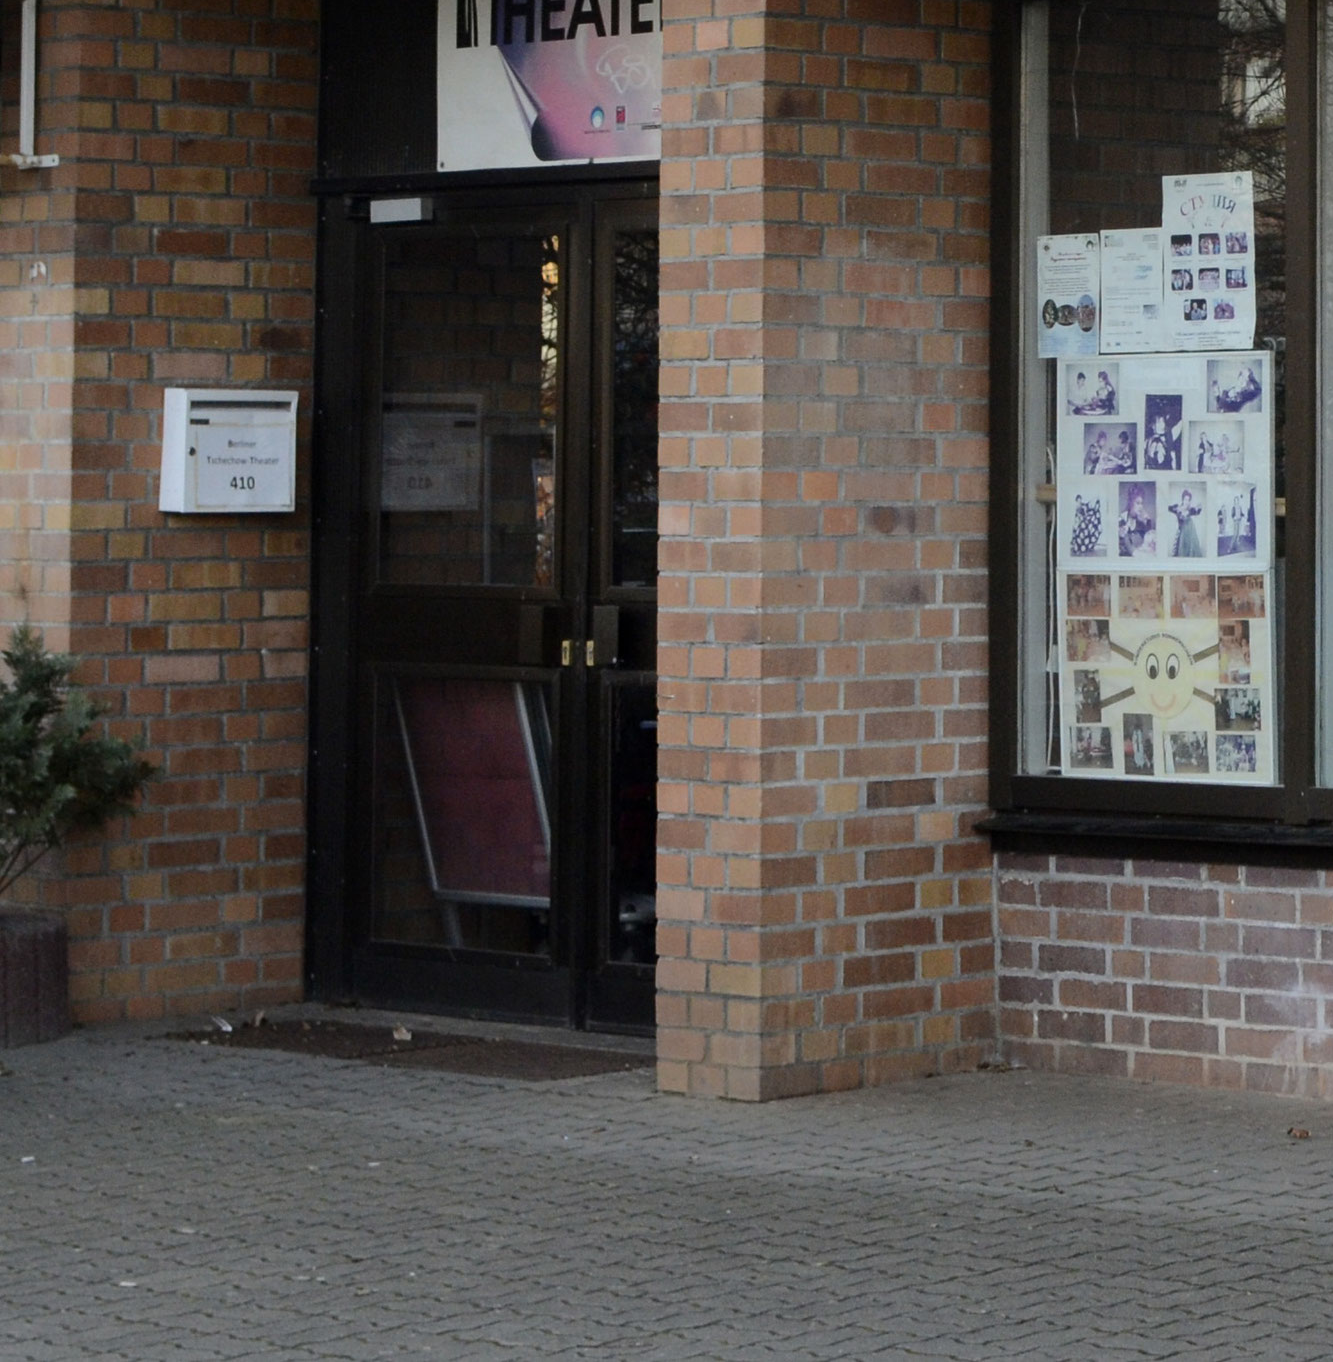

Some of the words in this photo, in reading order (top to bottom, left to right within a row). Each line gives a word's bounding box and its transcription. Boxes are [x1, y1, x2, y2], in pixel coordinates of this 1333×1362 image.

[207, 456, 246, 465] Tschechow
[250, 456, 279, 465] Theater
[230, 476, 255, 489] 410
